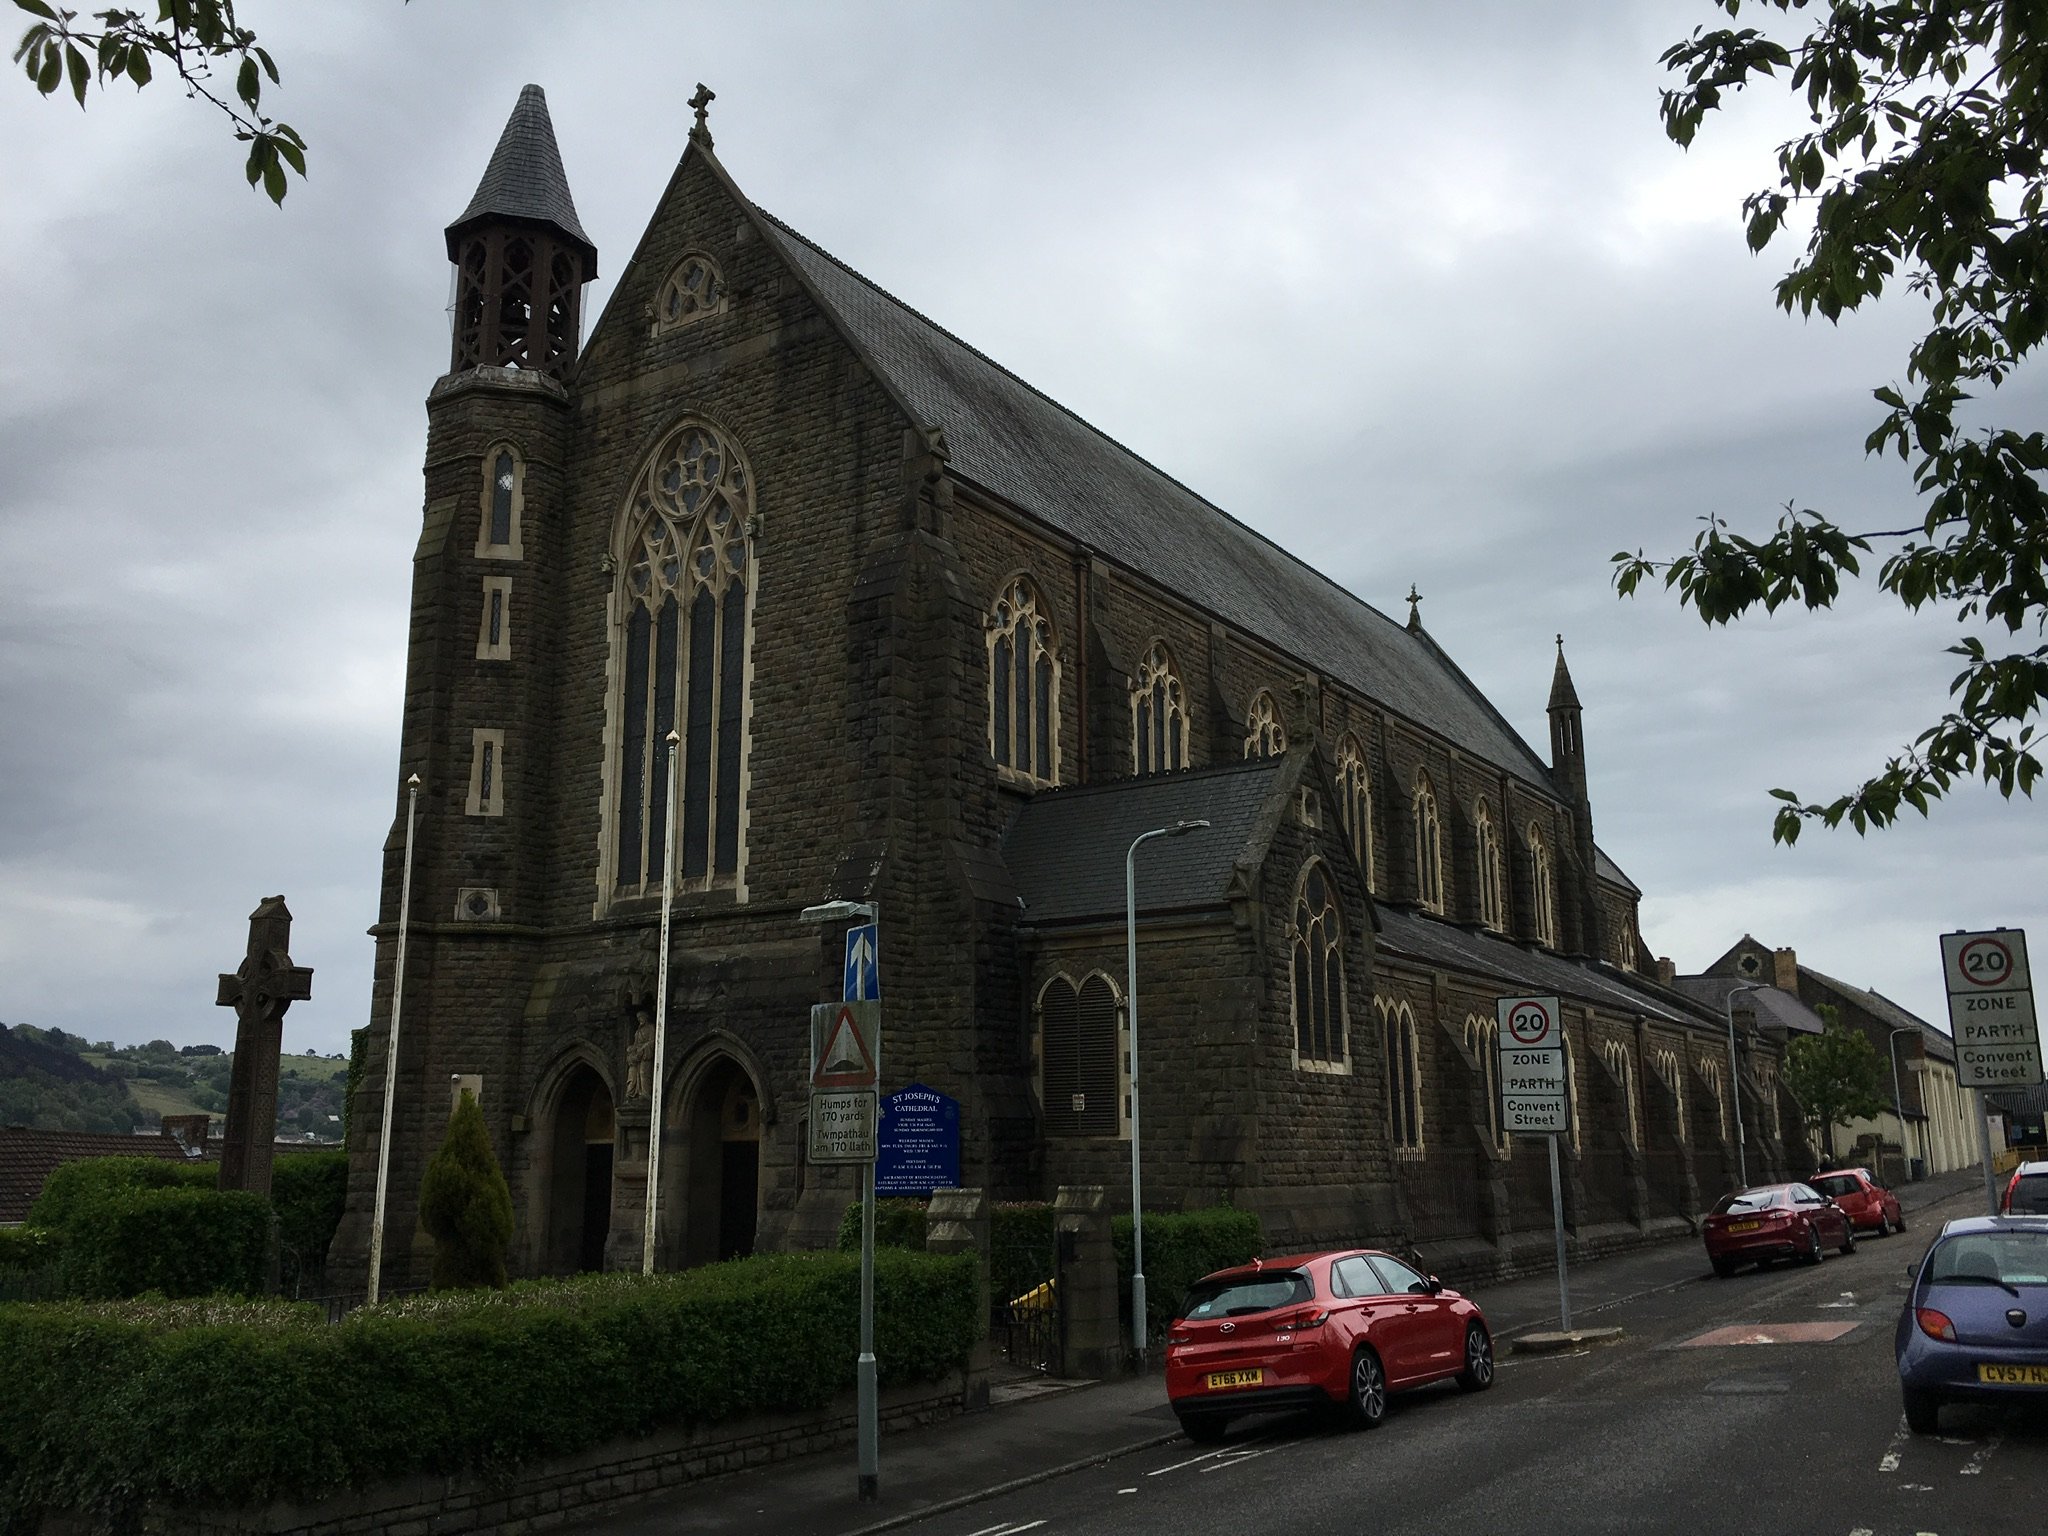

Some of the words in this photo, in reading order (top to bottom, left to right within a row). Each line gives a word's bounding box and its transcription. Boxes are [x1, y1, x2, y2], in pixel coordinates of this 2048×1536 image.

[1967, 952, 2005, 972] 20
[1966, 997, 2016, 1011] ZONE
[1515, 1014, 1544, 1032] 20
[1965, 1024, 2025, 1039] PARTH
[1512, 1054, 1550, 1065] ZONE
[1963, 1049, 2033, 1064] Convent
[1974, 1065, 2027, 1078] Street
[1510, 1078, 1555, 1090] PARTH
[820, 1098, 852, 1110] Humps
[854, 1097, 868, 1108] for
[892, 1094, 902, 1104] ST
[904, 1092, 941, 1104] JOSEPH'S
[1507, 1100, 1560, 1112] Convent
[821, 1112, 837, 1122] 170
[839, 1110, 865, 1123] yards
[1514, 1114, 1555, 1125] Street
[816, 1127, 869, 1141] Twmpathau
[814, 1143, 828, 1152] am
[831, 1141, 847, 1152] 170
[849, 1140, 871, 1152] llath
[1211, 1373, 1236, 1386] ET66
[1986, 1367, 2026, 1381] CV57
